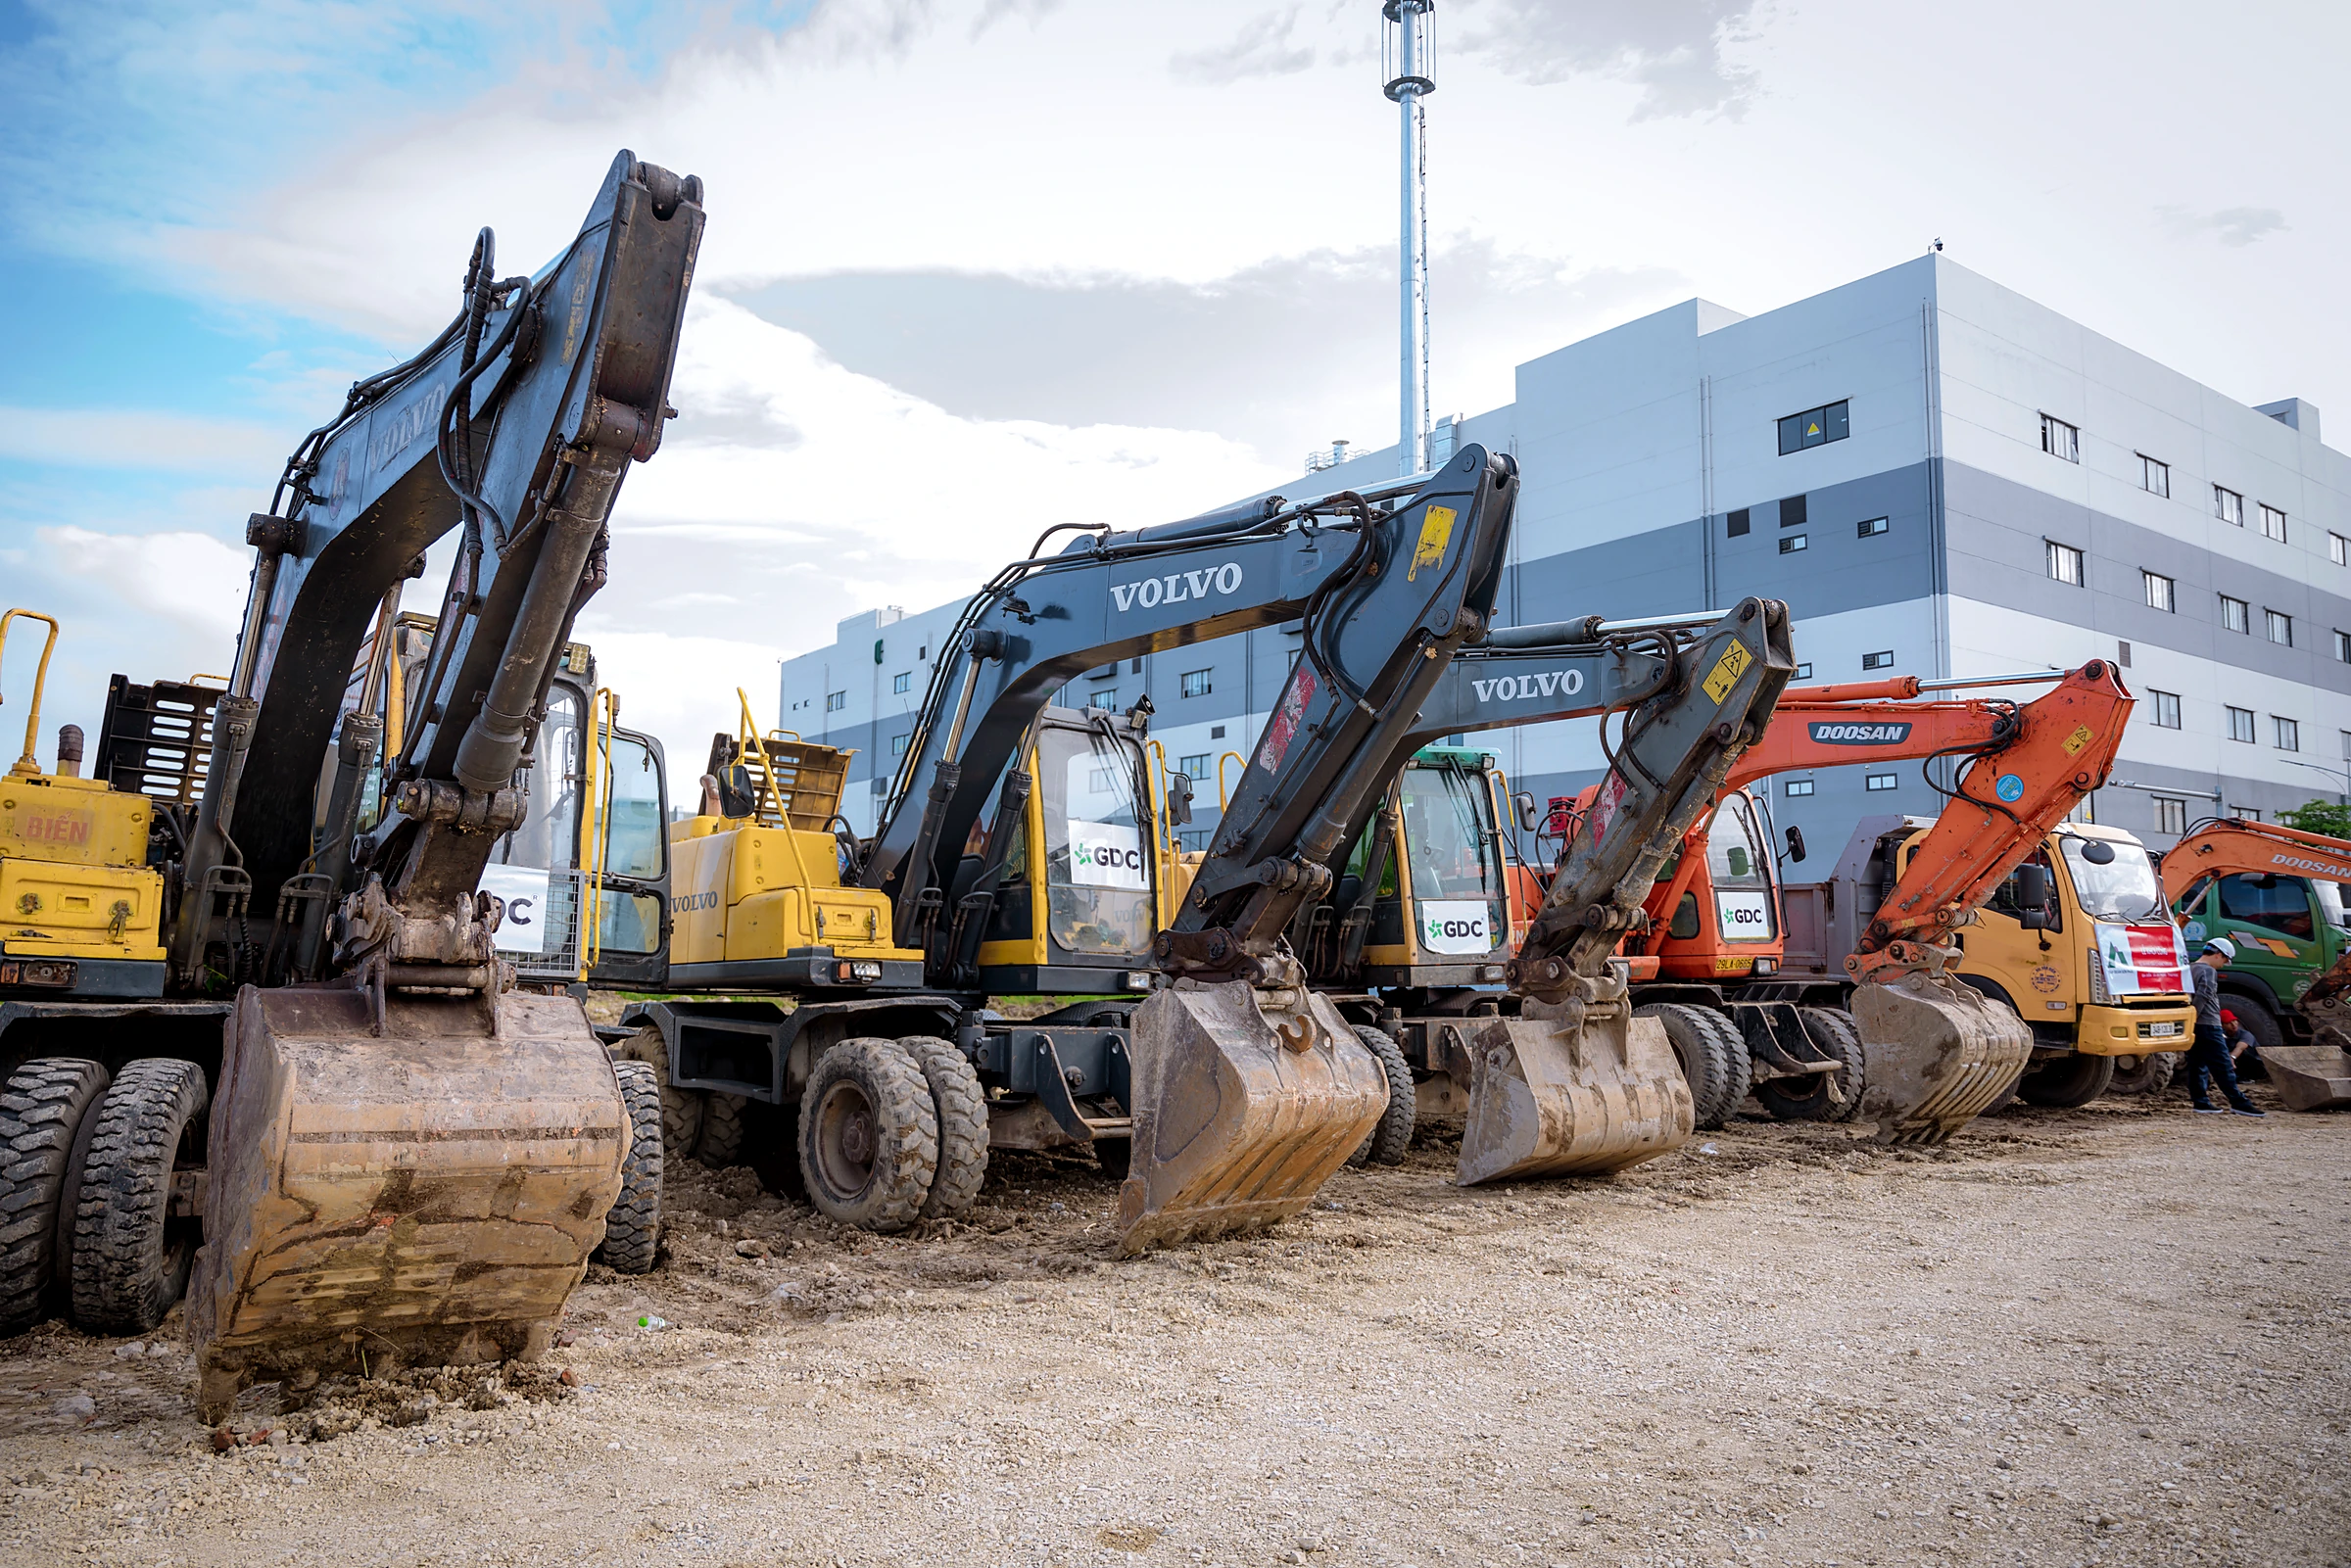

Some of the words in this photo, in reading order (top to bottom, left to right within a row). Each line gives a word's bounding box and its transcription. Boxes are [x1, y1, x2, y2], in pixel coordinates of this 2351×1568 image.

[1110, 562, 1243, 612] VOLVO
[1471, 669, 1584, 702] VOLVO
[1815, 726, 1903, 740] DOOSAN
[25, 810, 89, 843] BIỂN
[1093, 846, 1140, 871] GDC
[671, 890, 718, 914] VOLVO
[1734, 908, 1763, 924] GDC
[1443, 920, 1484, 938] GDC
